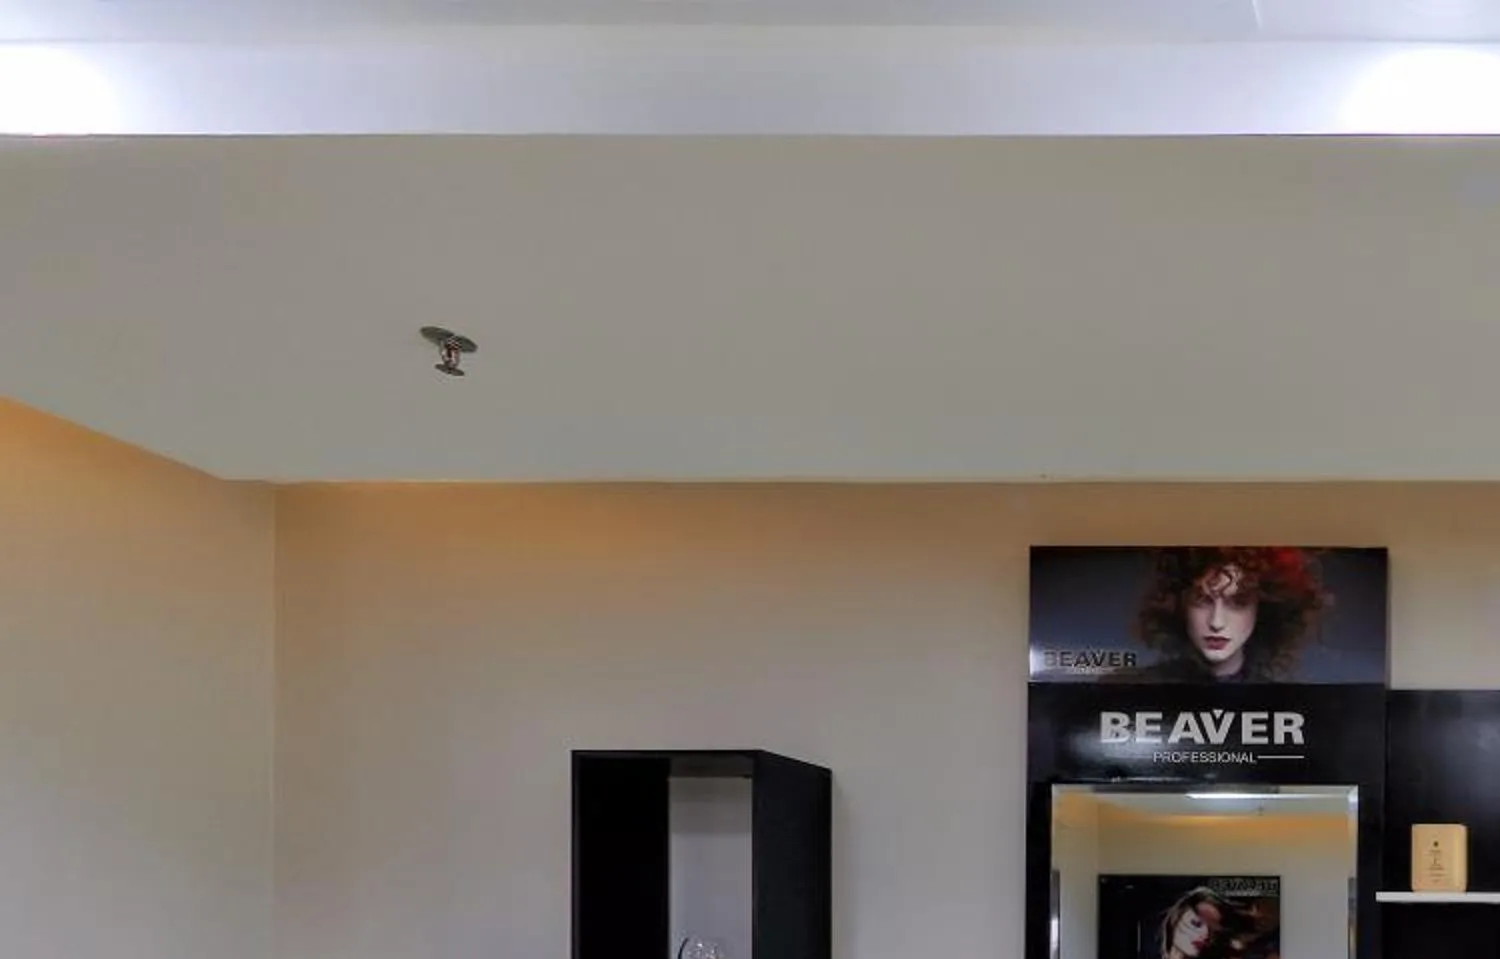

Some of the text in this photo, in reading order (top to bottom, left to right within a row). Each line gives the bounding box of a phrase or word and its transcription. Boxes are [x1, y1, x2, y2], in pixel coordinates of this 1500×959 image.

[1043, 646, 1137, 667] BEAVER
[1100, 709, 1305, 745] BEAVER
[1152, 751, 1257, 764] PROFESSIONAL
